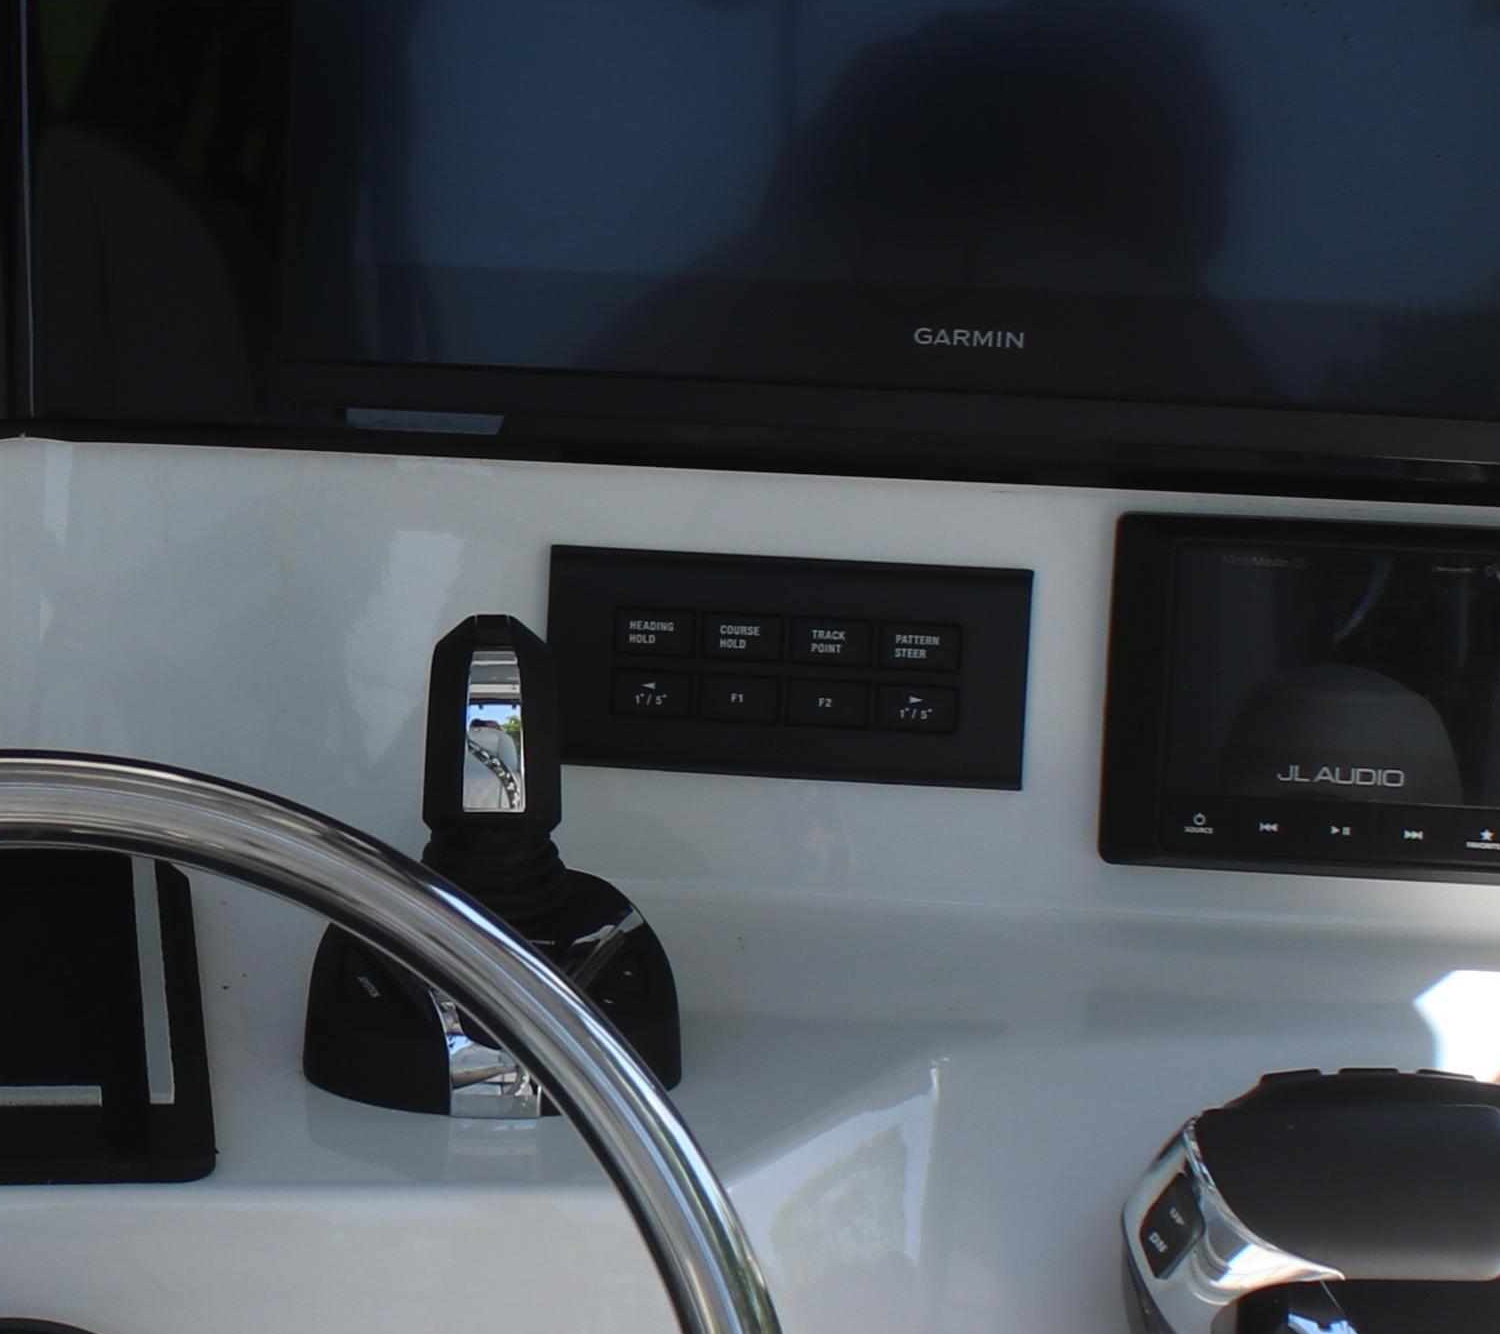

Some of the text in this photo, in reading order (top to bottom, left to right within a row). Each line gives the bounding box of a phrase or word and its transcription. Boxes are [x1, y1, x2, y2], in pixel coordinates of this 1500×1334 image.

[914, 327, 1024, 349] GARMIN
[629, 620, 674, 632] HEADING
[720, 625, 760, 637] COURSE
[629, 633, 656, 644] HOLD
[812, 629, 846, 641] TRACK
[895, 634, 940, 646] PATTERN
[720, 638, 746, 649] HOLD
[811, 643, 841, 654] POINT
[894, 648, 927, 659] STEER
[731, 694, 743, 703] F1
[819, 698, 832, 708] F2
[1276, 765, 1405, 787] JL AUDIO
